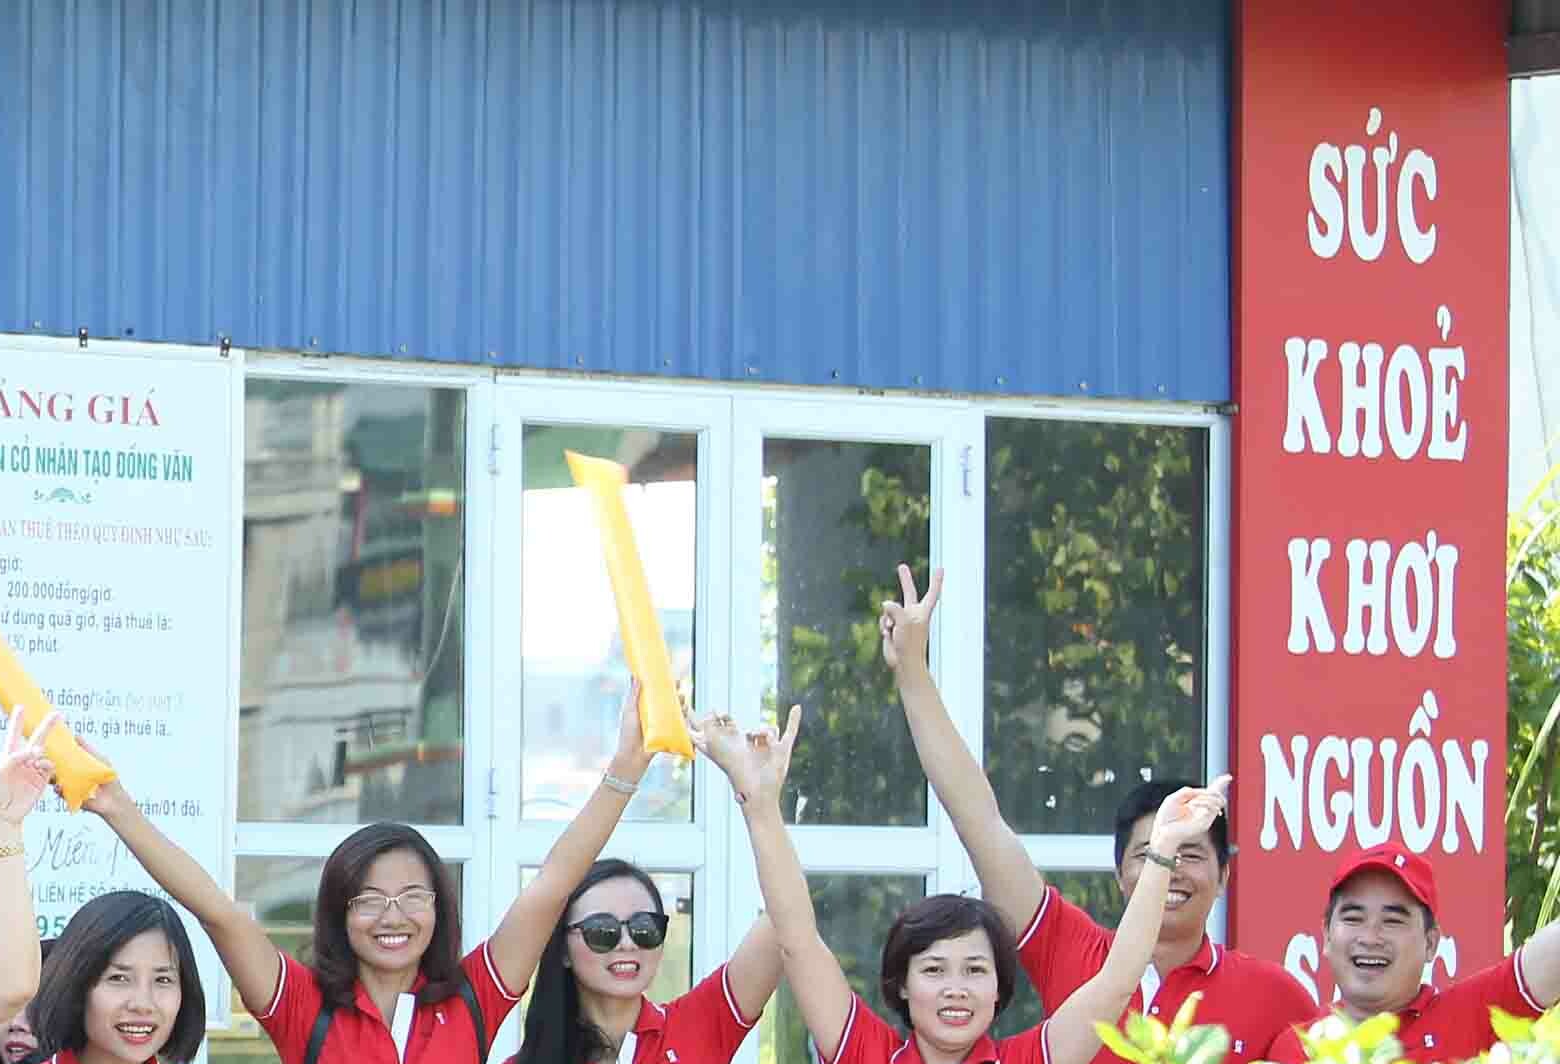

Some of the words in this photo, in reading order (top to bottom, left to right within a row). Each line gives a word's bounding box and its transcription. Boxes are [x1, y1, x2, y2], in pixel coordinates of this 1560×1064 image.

[1308, 106, 1438, 264] SỨC
[88, 387, 160, 426] GIÁ
[1283, 304, 1467, 462] KHOẺ
[11, 434, 32, 474] CỎ
[36, 442, 79, 477] NHÂN
[83, 449, 111, 484] TẠO
[162, 449, 193, 483] VĂN
[1287, 529, 1458, 660] KHƠI
[1260, 688, 1489, 854] NGUỒN
